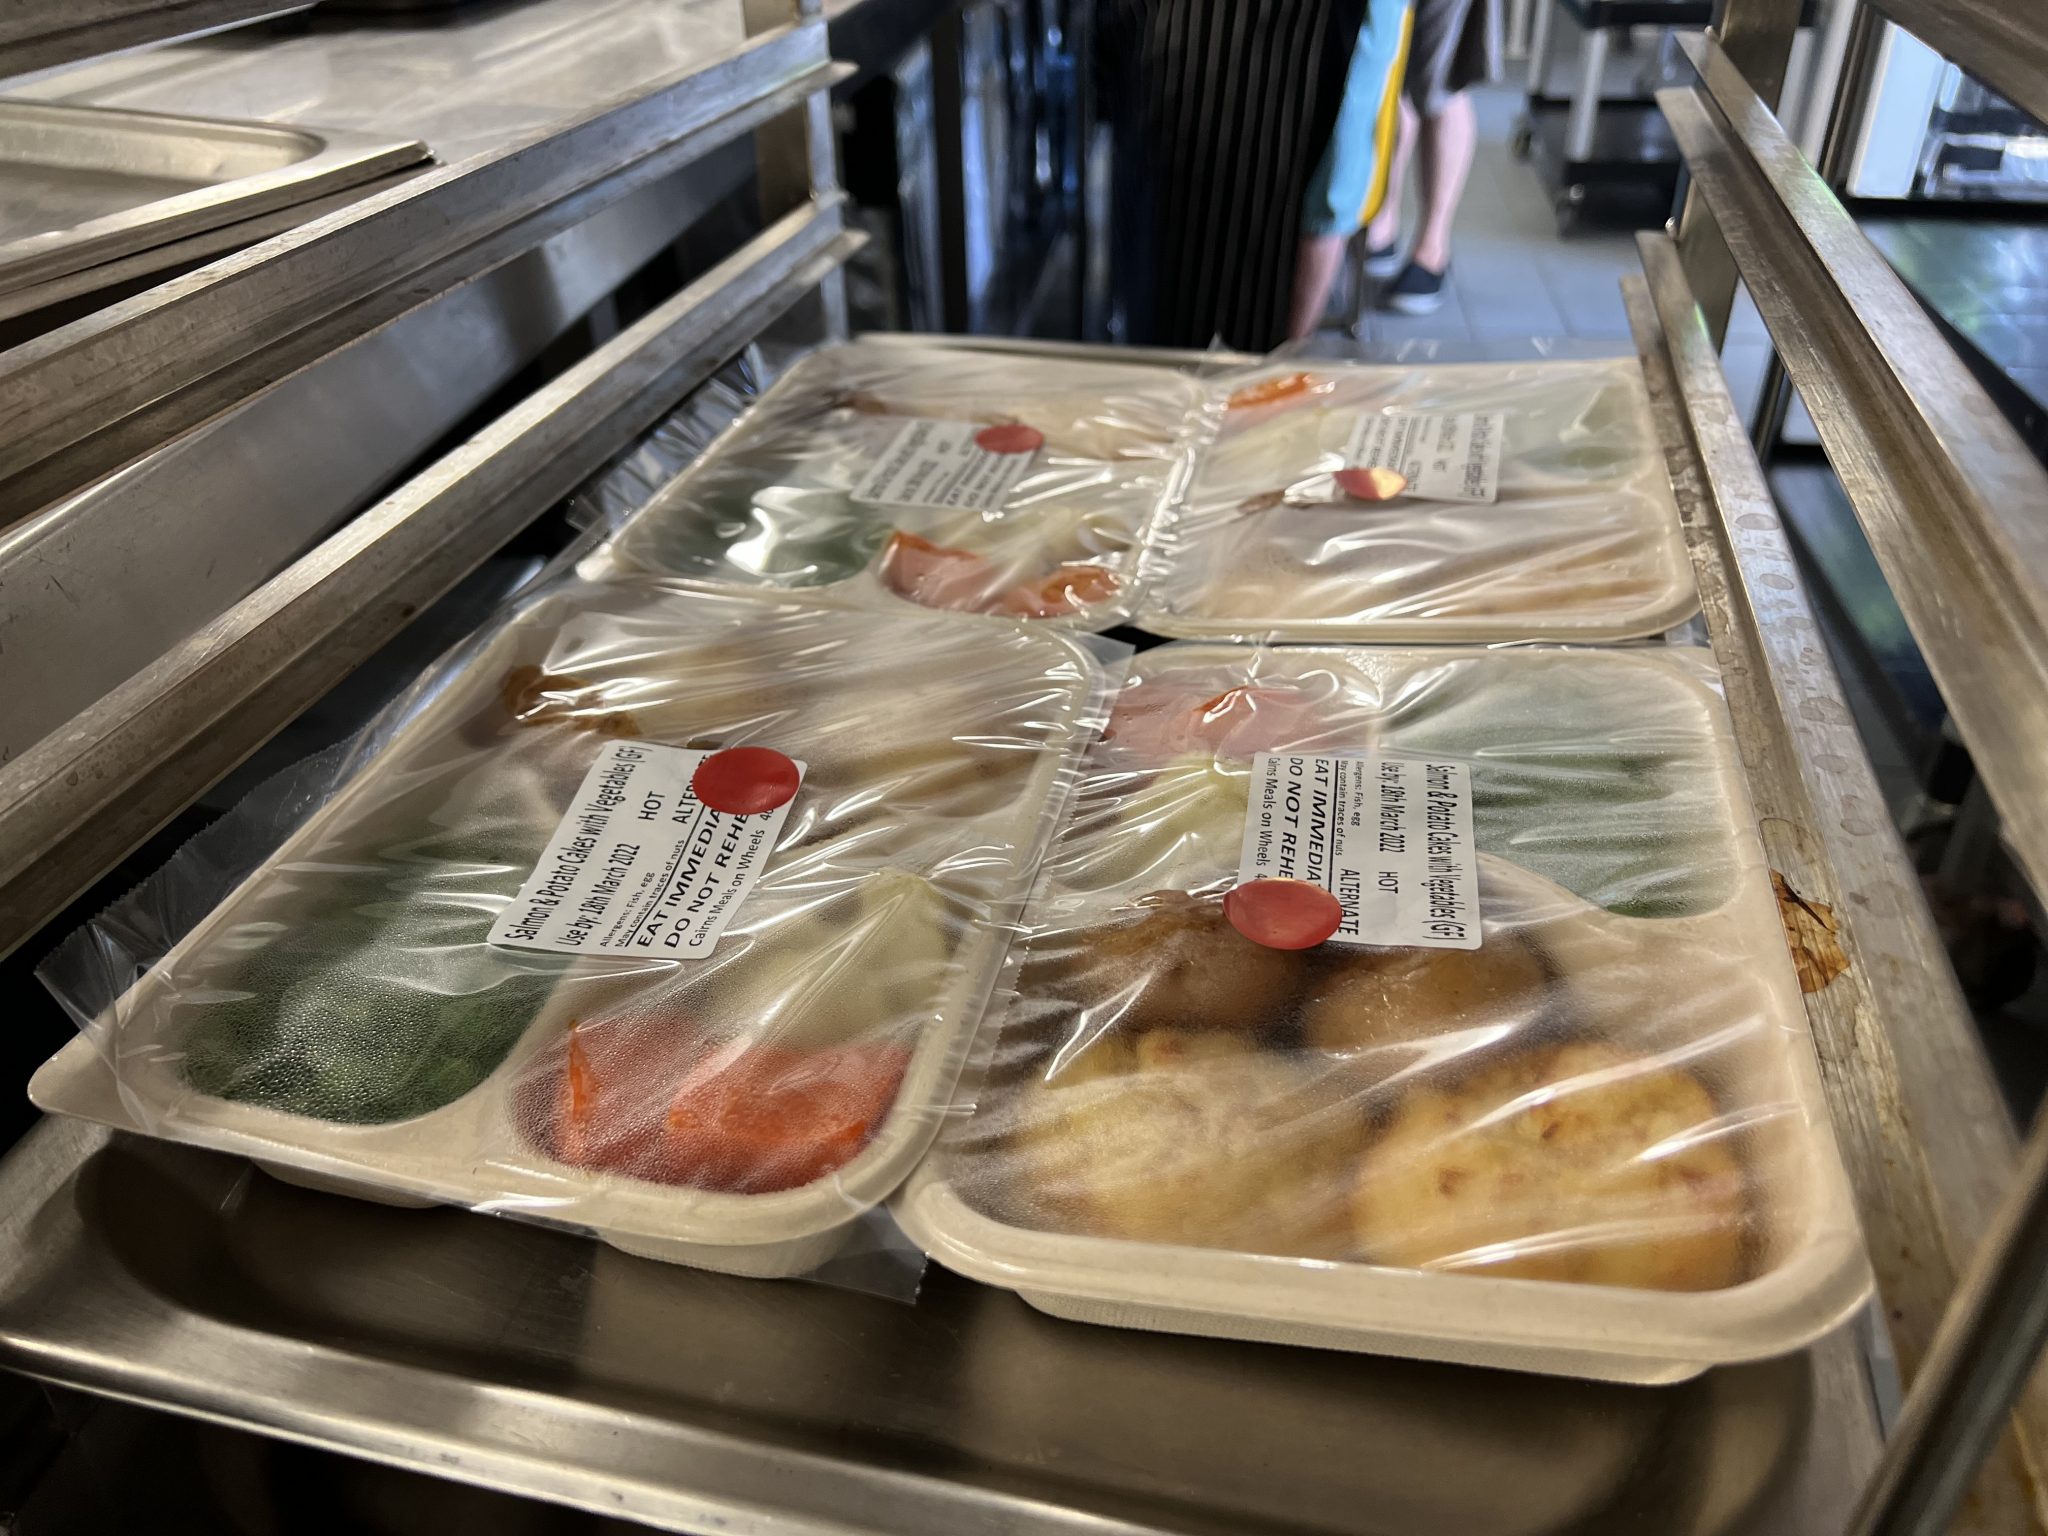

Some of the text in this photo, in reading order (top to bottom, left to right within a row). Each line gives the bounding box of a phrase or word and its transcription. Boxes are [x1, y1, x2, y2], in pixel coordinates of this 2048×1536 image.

[611, 745, 654, 763] (GF)
[1265, 757, 1280, 777] Cairns
[1289, 756, 1304, 777] DO
[1313, 758, 1329, 787] EAT
[1425, 764, 1458, 789] Salmon
[585, 763, 637, 813] Vegetables
[1261, 778, 1278, 809] Meals
[1338, 773, 1348, 800] contain
[1353, 791, 1364, 809] Fish,
[1381, 784, 1407, 804] 18th
[637, 790, 666, 821] HOT
[1284, 780, 1301, 828] NOT
[1336, 801, 1346, 827] traces
[1379, 804, 1406, 831] March
[1426, 800, 1458, 832] Potato
[576, 815, 611, 838] with
[1261, 811, 1272, 827] on
[1335, 826, 1345, 838] of
[1350, 810, 1361, 827] egg
[557, 836, 598, 864] Cakes
[737, 828, 766, 870] Wheels
[1255, 829, 1273, 867] Wheels
[1334, 839, 1344, 857] nuts
[1379, 832, 1405, 853] 2022
[1427, 831, 1461, 856] Cakes
[1428, 855, 1463, 874] with
[536, 864, 581, 899] Potato
[614, 927, 632, 948] May
[630, 900, 652, 928] contain
[649, 872, 668, 901] traces
[671, 838, 685, 861] nuts
[732, 872, 746, 888] on
[1377, 871, 1398, 894] HOT
[555, 842, 641, 946] Use by: 18th March 2022
[708, 888, 737, 917] Meals
[1420, 874, 1466, 918] Vegetables
[599, 871, 656, 948] Allergens: Fish, egg
[663, 917, 691, 949] DO
[687, 872, 720, 913] NOT
[504, 906, 550, 941] Salmon
[637, 909, 669, 948] EAT
[688, 914, 718, 947] Cairns
[1421, 920, 1468, 940] (GF)
